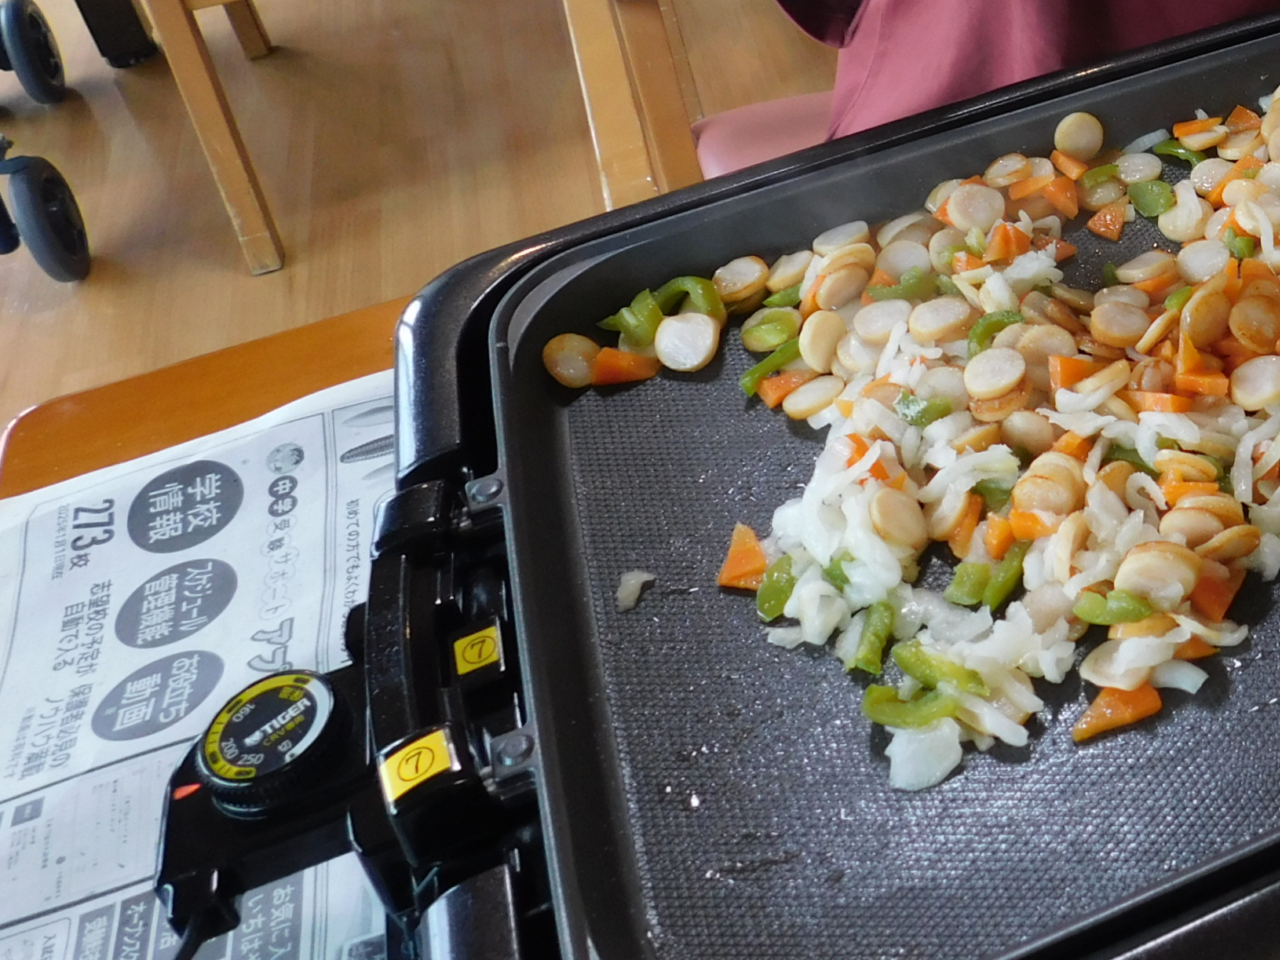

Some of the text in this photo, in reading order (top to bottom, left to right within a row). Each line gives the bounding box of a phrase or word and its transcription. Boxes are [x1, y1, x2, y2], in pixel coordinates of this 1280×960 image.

[68, 497, 116, 571] 273校
[148, 481, 185, 544] 情報
[187, 472, 222, 533] 学校
[75, 579, 113, 678] 志望校の予定が
[135, 572, 181, 646] 管理機能
[178, 561, 214, 633] スケジュール
[52, 600, 86, 672] 自動で入る
[112, 672, 163, 732] 動画
[158, 652, 202, 724] お役立ち
[231, 702, 257, 723] 160
[260, 697, 313, 735] TIGER
[220, 736, 239, 760] 200
[237, 753, 265, 766] 250
